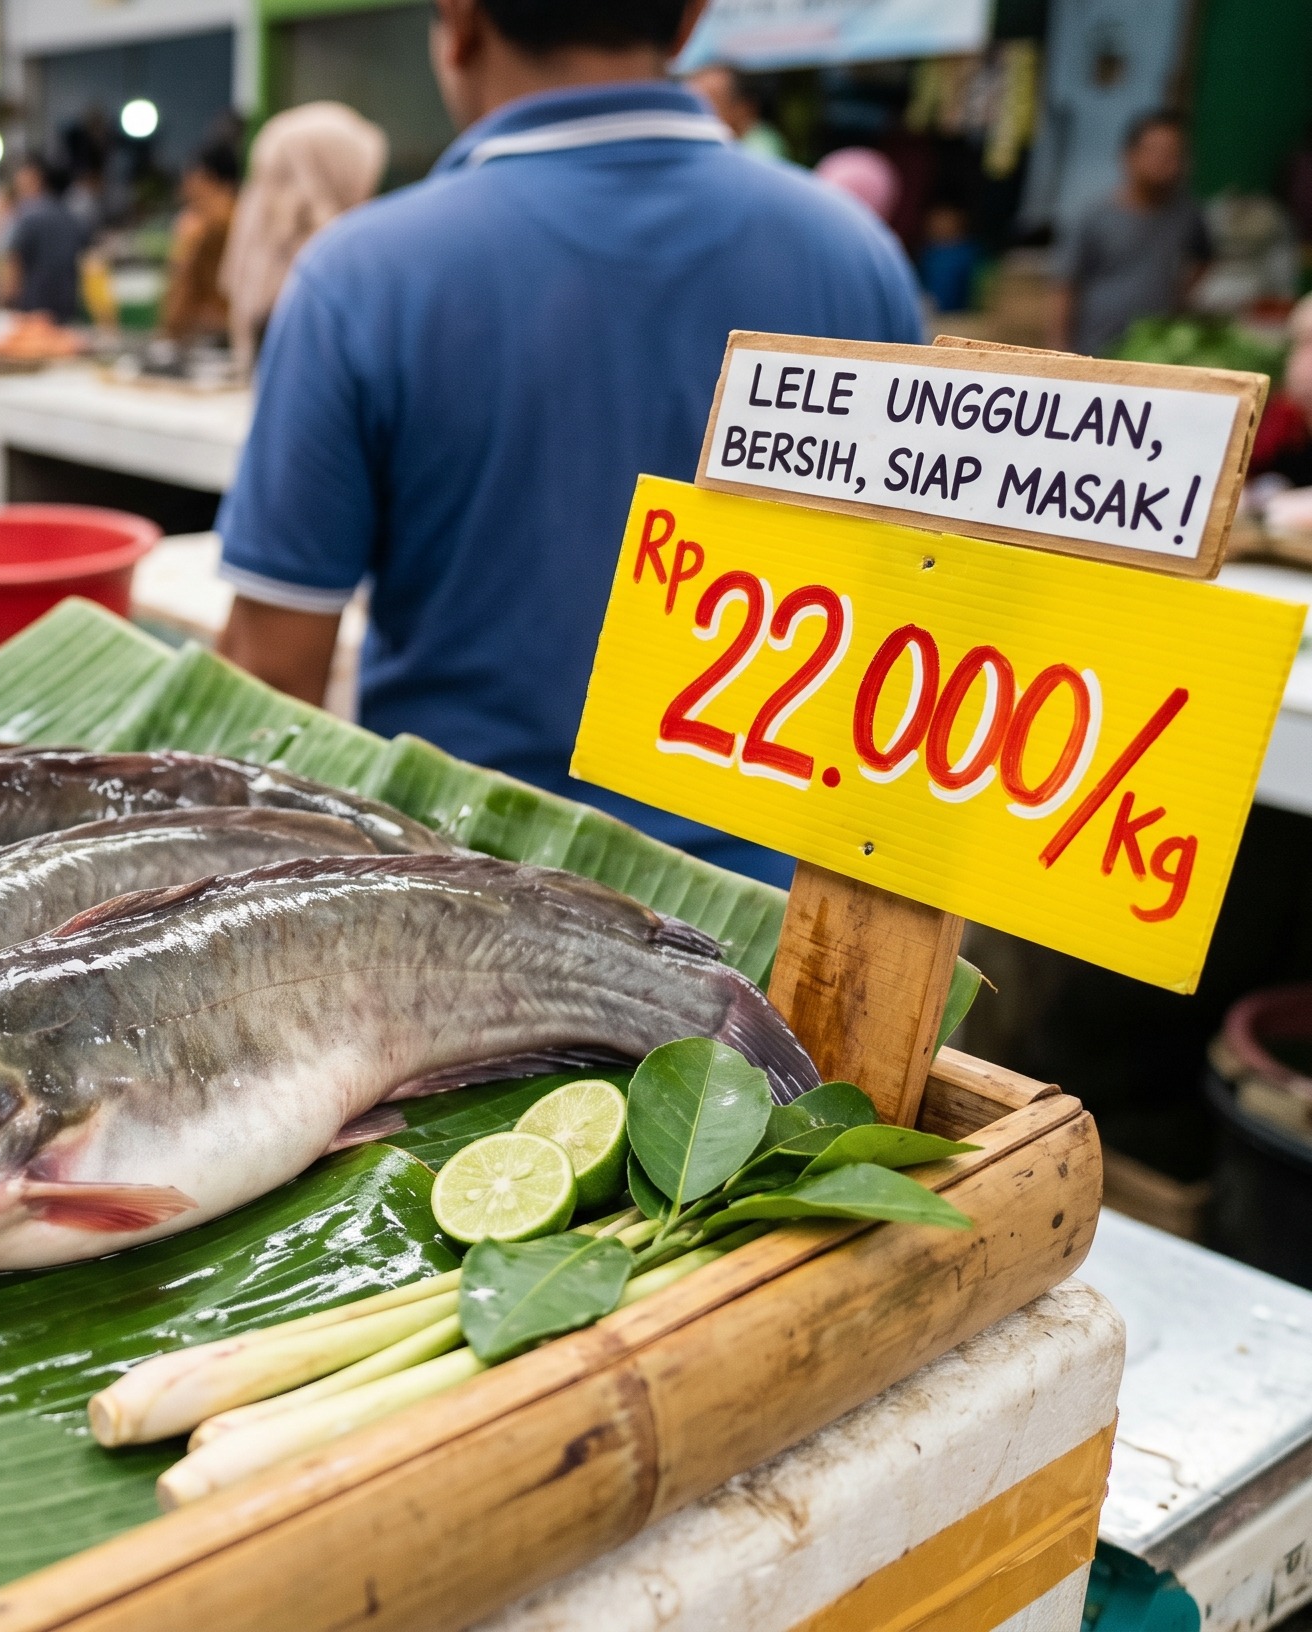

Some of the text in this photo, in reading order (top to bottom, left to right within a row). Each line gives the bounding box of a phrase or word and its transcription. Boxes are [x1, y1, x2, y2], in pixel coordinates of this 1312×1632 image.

[749, 363, 1164, 461] LELE UNGGULAN,
[721, 426, 1201, 545] BERSIH, SIAP MASAK!
